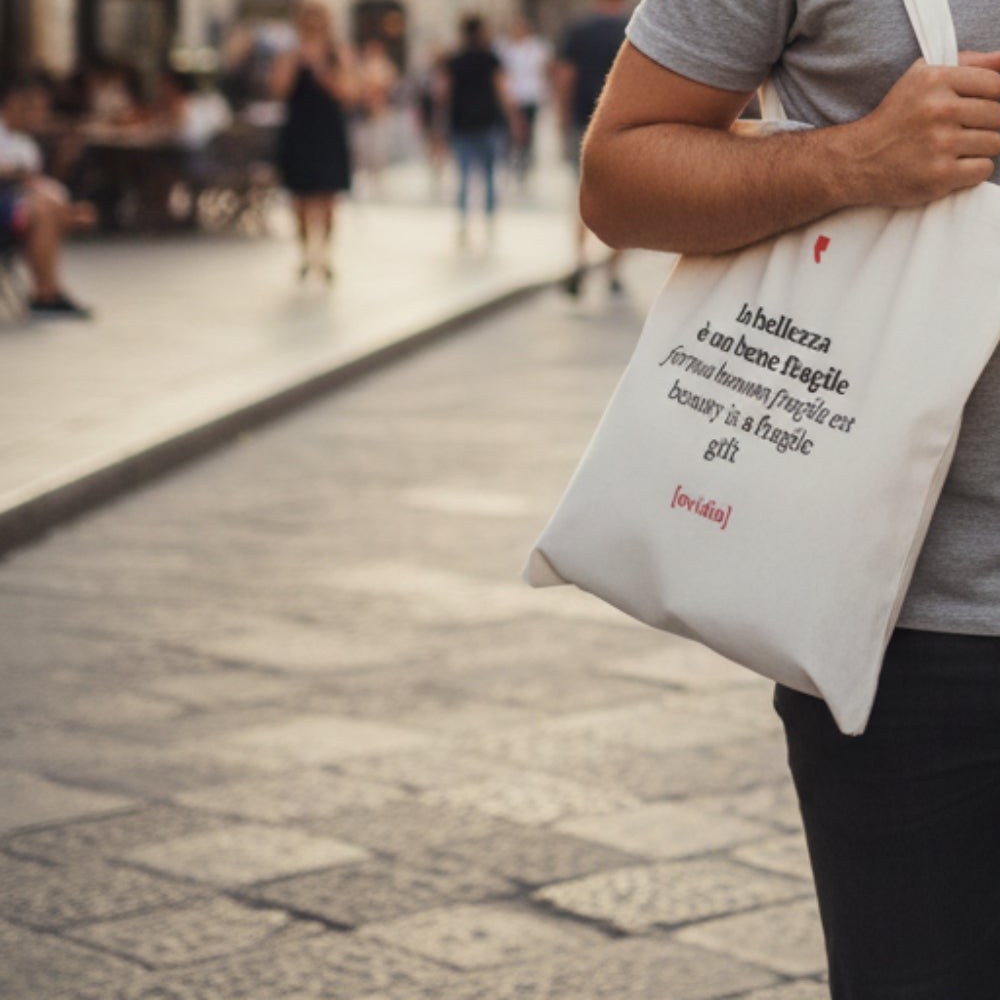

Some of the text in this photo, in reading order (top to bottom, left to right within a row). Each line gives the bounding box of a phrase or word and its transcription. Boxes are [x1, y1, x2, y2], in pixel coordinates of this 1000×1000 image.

[697, 321, 711, 342] è
[733, 334, 780, 372] bene
[751, 306, 832, 354] bellezza
